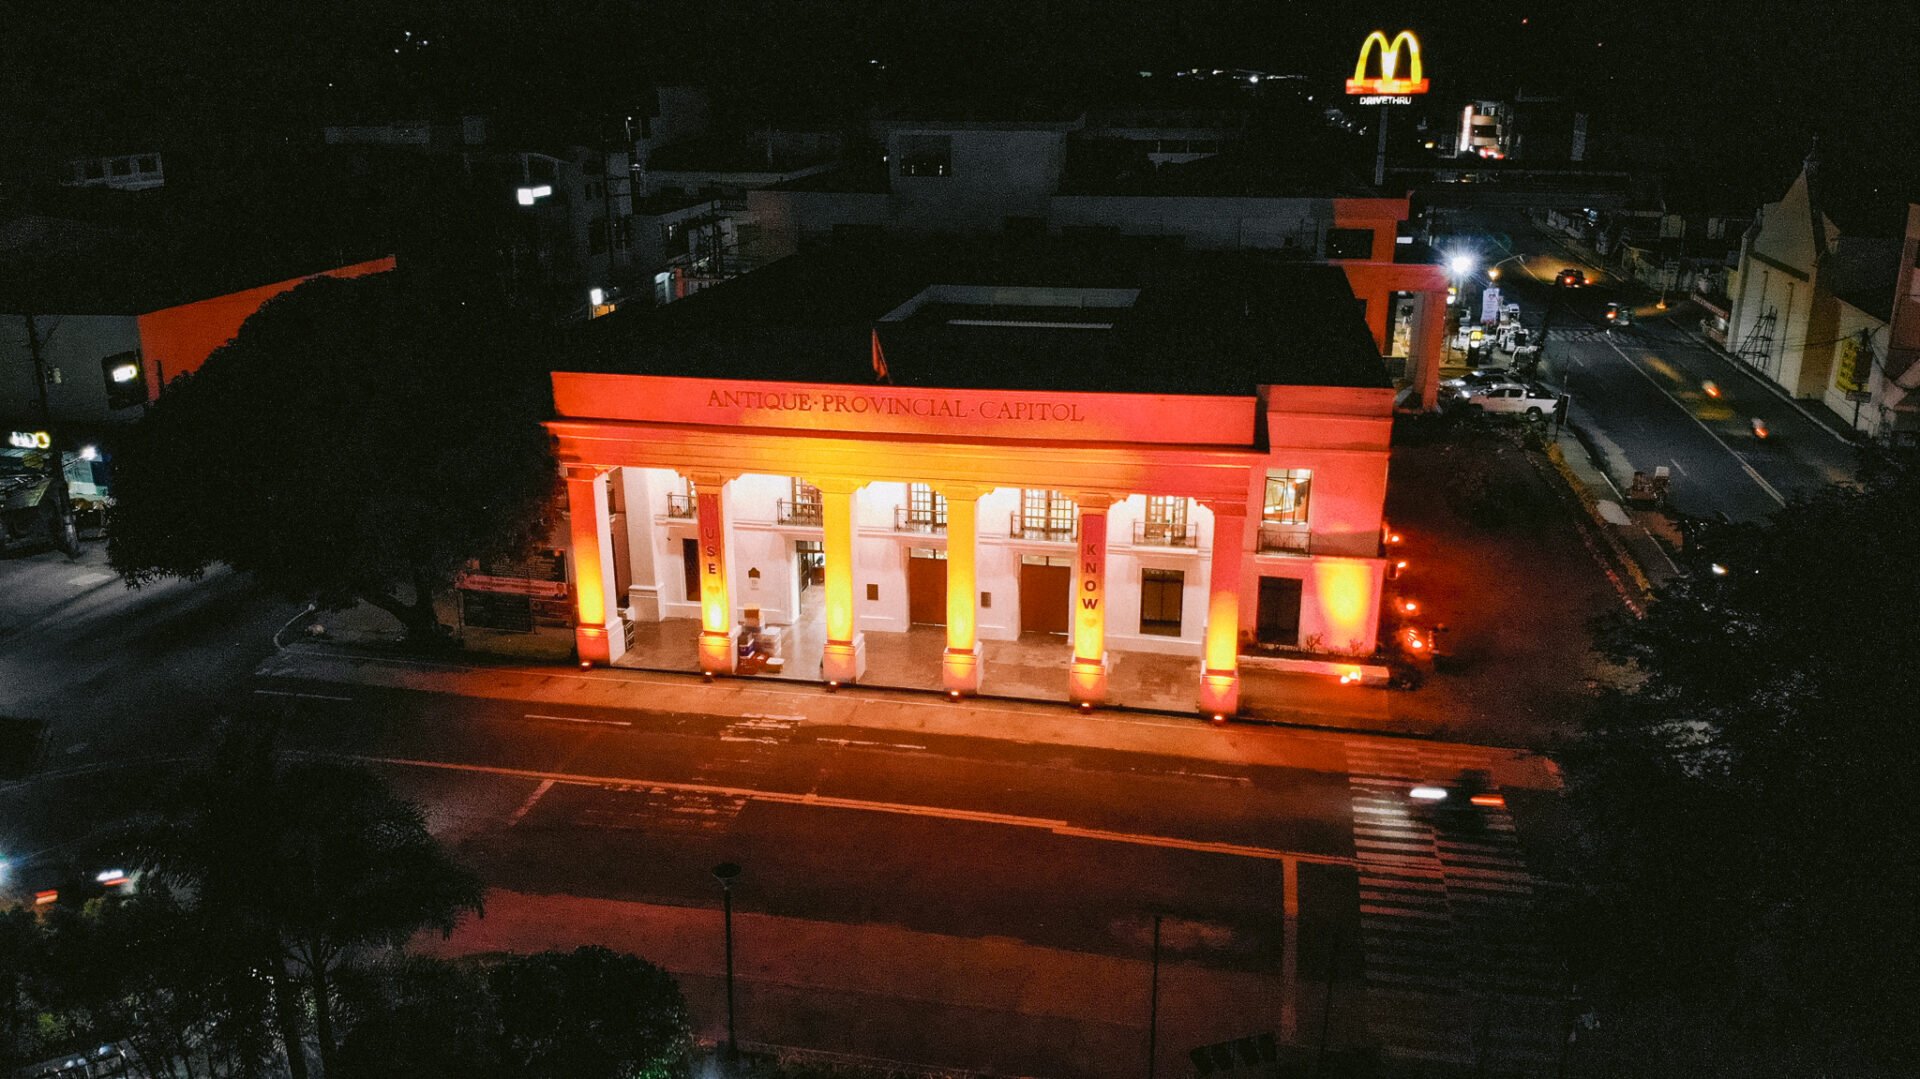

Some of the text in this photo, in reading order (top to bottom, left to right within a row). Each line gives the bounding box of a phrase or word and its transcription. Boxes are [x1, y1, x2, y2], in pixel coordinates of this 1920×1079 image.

[707, 389, 1085, 422] ANTIQUE PROVINCIAL CAPITOL
[705, 527, 717, 575] USE
[1082, 544, 1099, 610] KNOW
